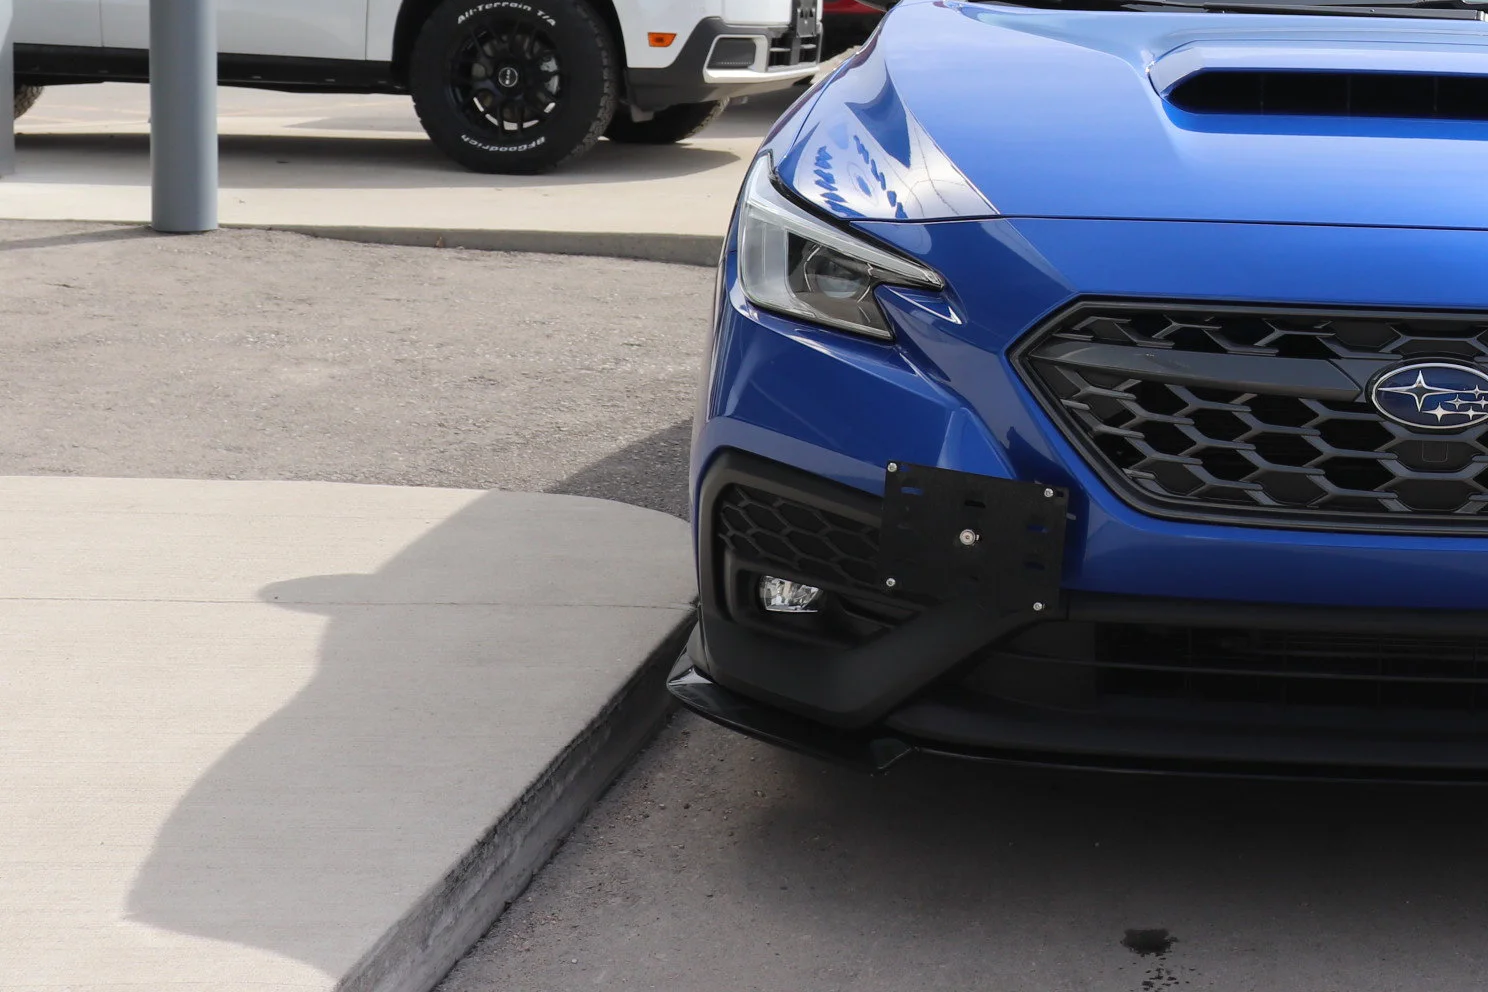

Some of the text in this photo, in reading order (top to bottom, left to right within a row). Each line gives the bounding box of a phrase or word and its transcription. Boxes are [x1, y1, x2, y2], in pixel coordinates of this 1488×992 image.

[457, 1, 556, 27] All-Terrain T/A
[461, 134, 546, 152] BFGoodrich
